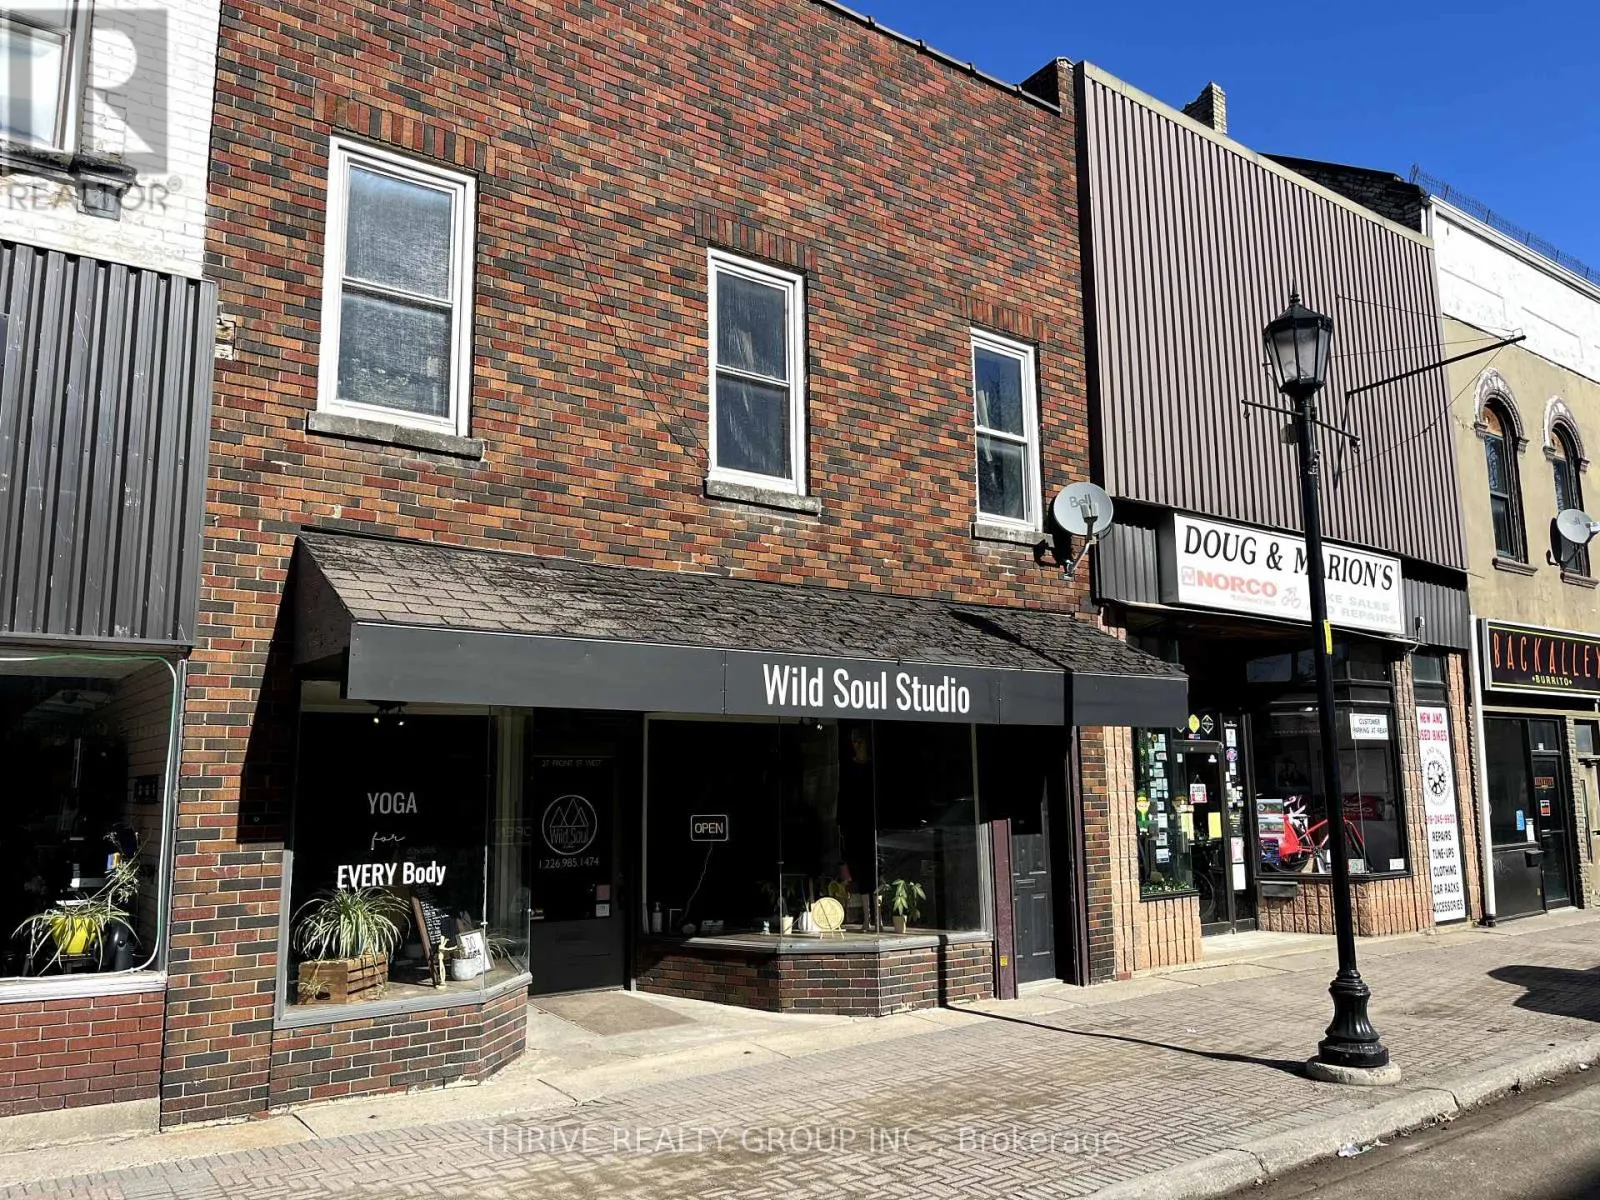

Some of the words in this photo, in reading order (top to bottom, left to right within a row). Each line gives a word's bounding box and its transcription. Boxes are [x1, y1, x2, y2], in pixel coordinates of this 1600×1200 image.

[1069, 494, 1092, 508] Bell
[1184, 525, 1257, 566] DOUG
[1266, 542, 1283, 572] &
[1294, 546, 1393, 591] MRION'S
[1197, 571, 1278, 598] NORCO
[1349, 596, 1390, 612] SALES
[1342, 607, 1397, 625] REPAIRS
[1535, 674, 1568, 686] BURRITO
[763, 664, 824, 708] Wild
[833, 668, 887, 711] Soul
[896, 672, 970, 714] Studio
[367, 791, 418, 815] YOGA
[694, 821, 724, 835] OPEN
[1432, 830, 1452, 842] REPAIRS
[371, 831, 407, 851] for
[337, 863, 397, 890] EVERY
[402, 861, 447, 886] Body
[1433, 864, 1457, 877] CLOTHING
[1434, 883, 1444, 896] CAR
